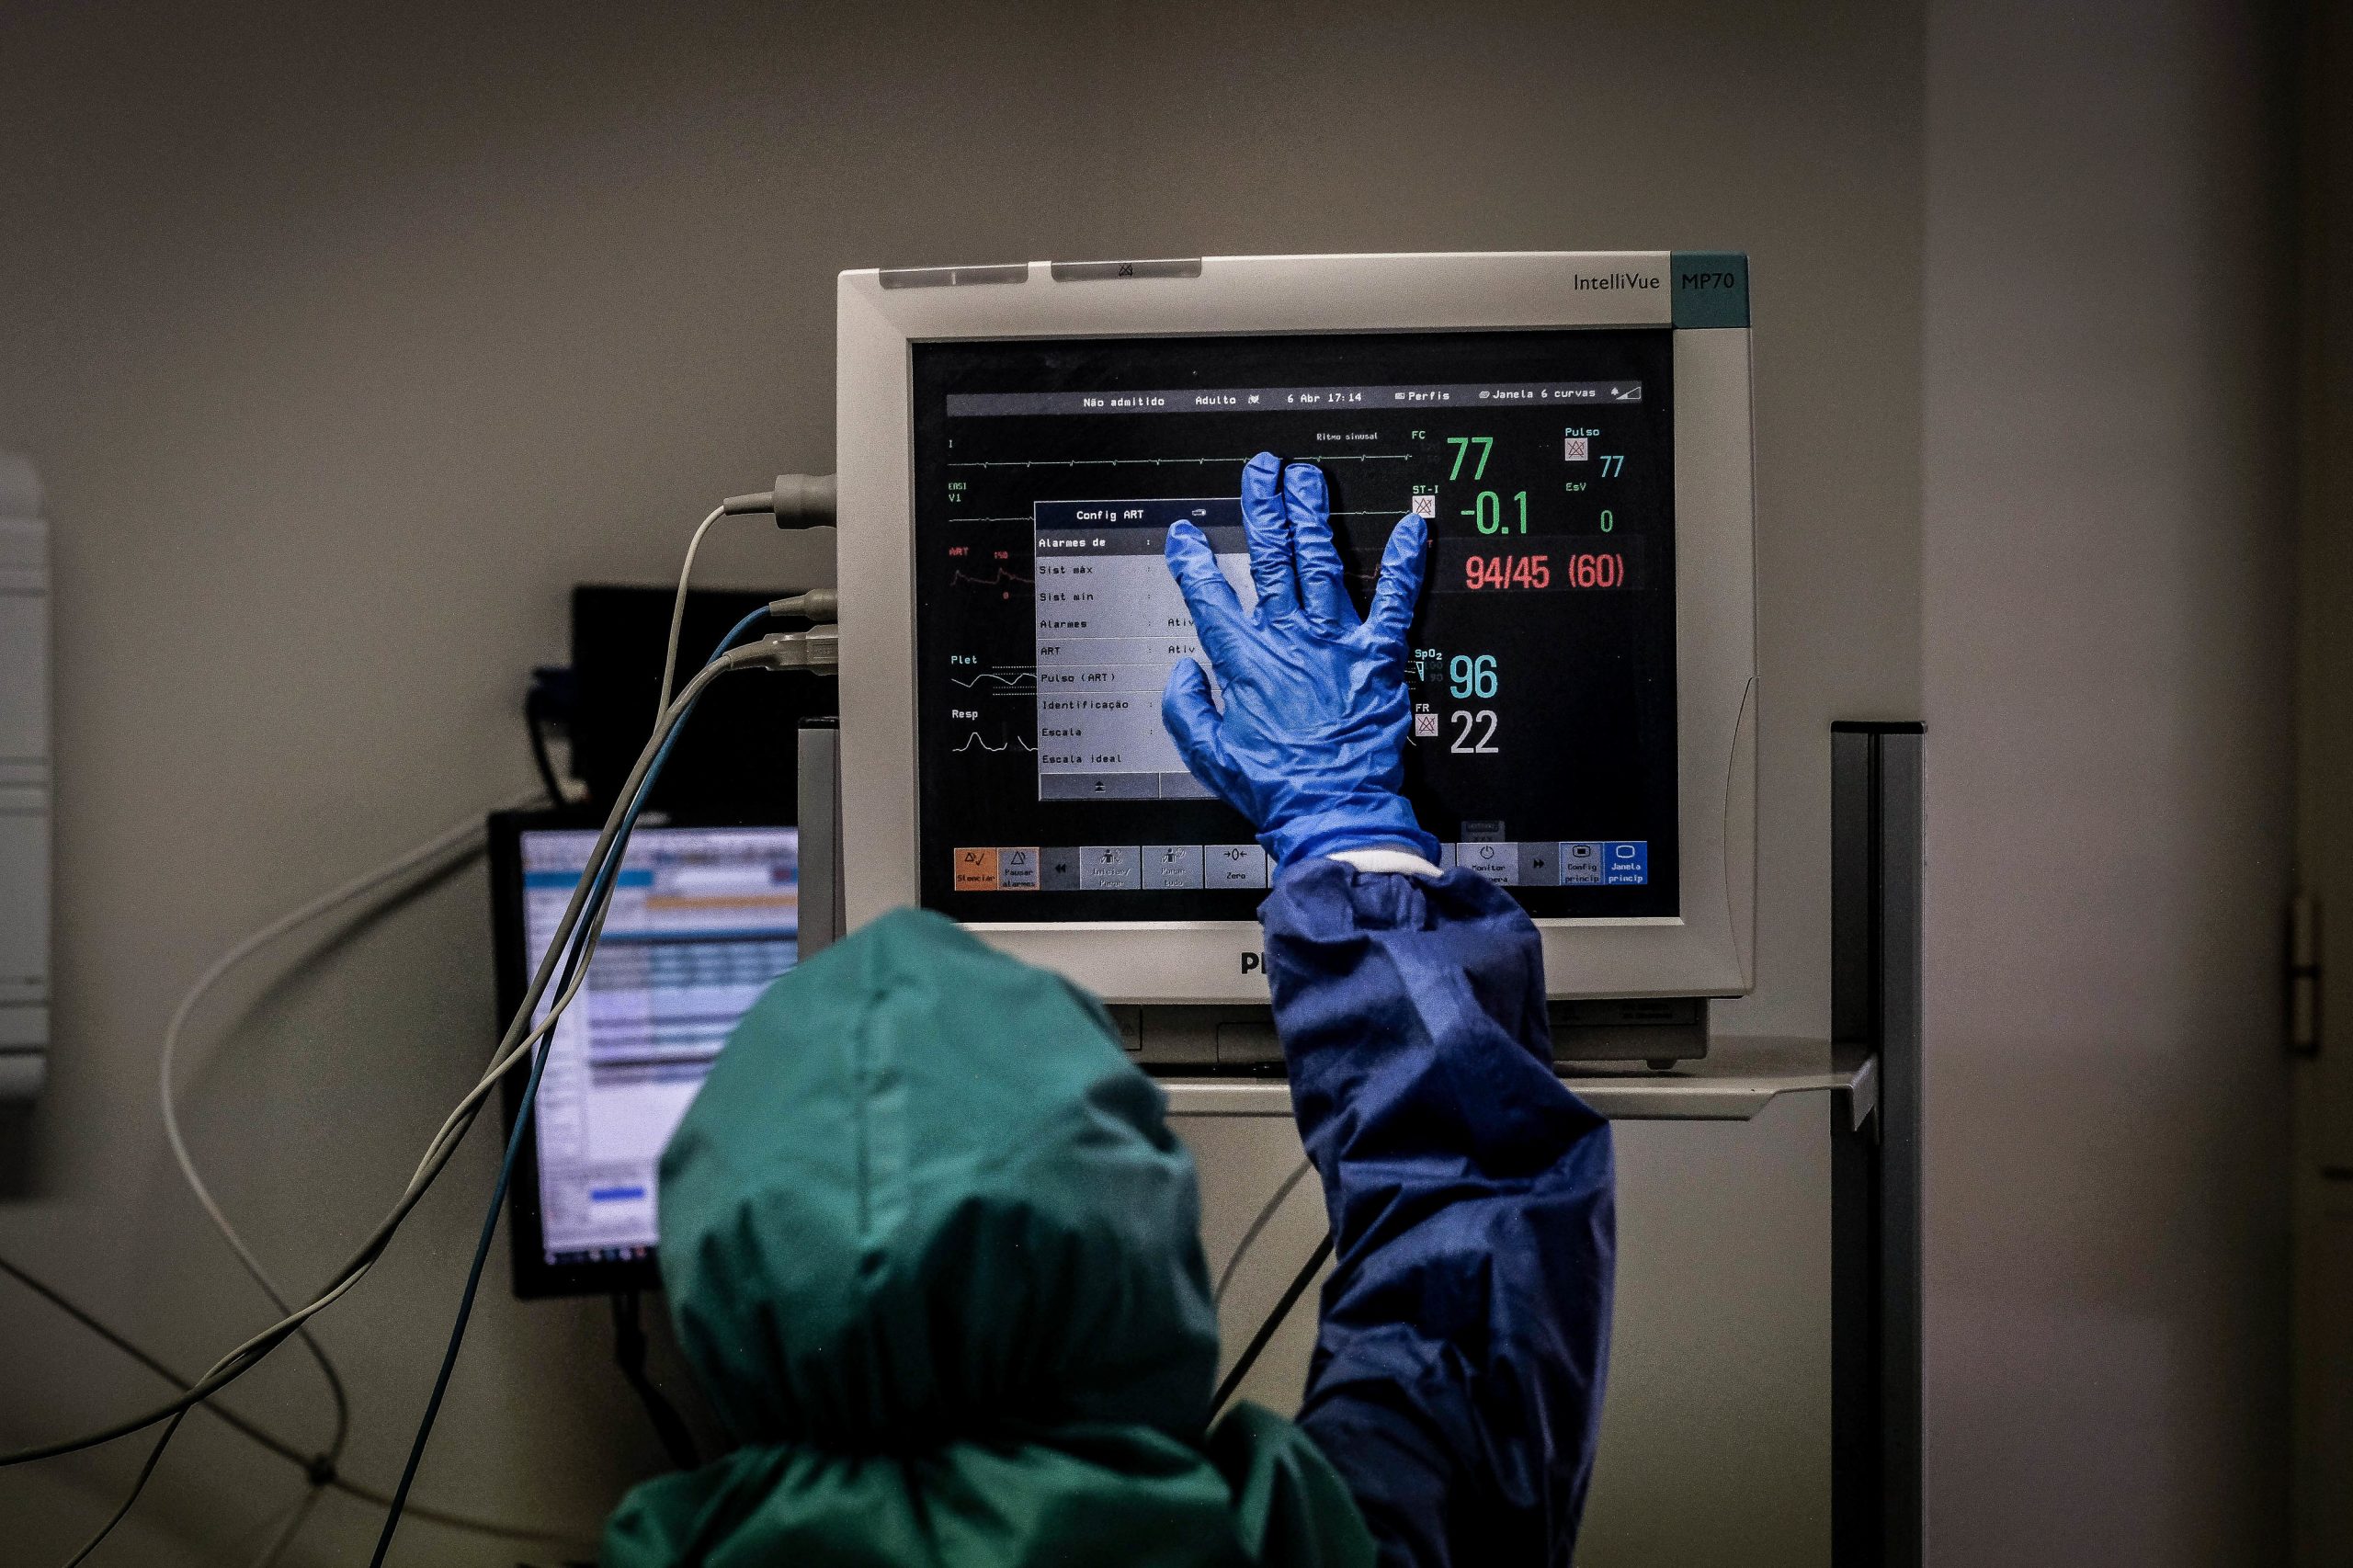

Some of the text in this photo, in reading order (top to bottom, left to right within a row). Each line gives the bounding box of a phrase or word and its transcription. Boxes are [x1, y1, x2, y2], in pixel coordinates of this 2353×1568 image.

[1574, 273, 1660, 290] IntelliVue
[1682, 272, 1734, 290] MP70
[1287, 392, 1362, 403] 6 Abr 17:14
[1408, 392, 1450, 401] Perfis
[1493, 389, 1596, 400] Janela 6 curvas
[1083, 396, 1165, 408] Não admitido
[1195, 395, 1237, 405] Adulto
[1345, 431, 1378, 441] sinusal
[1411, 430, 1427, 440] FC
[1564, 427, 1600, 437] Pulso
[1447, 437, 1494, 480] 77
[1599, 455, 1625, 478] 77
[1565, 483, 1587, 492] EsV
[1076, 509, 1144, 522] Config ART
[1461, 491, 1528, 534] -0.1
[1600, 510, 1613, 532] 0
[1039, 538, 1106, 548] Alarmes de
[1039, 565, 1066, 574] Sist
[1465, 553, 1624, 589] 94/45 (60)
[1040, 592, 1066, 602] Sist
[1040, 619, 1087, 629] Alarmes
[1040, 646, 1061, 655] ART
[950, 654, 978, 665] Plet
[1040, 673, 1115, 683] Pulso (ART)
[1449, 654, 1498, 699] 96
[1042, 699, 1129, 711] Identificação
[1415, 703, 1430, 712] FR
[951, 710, 979, 721] Resp
[1041, 727, 1082, 736] Escala
[1450, 710, 1499, 754] 22
[1042, 754, 1121, 764] Escala ideal
[1567, 863, 1597, 873] Config
[1610, 862, 1642, 871] Janela
[1608, 874, 1643, 884] princip
